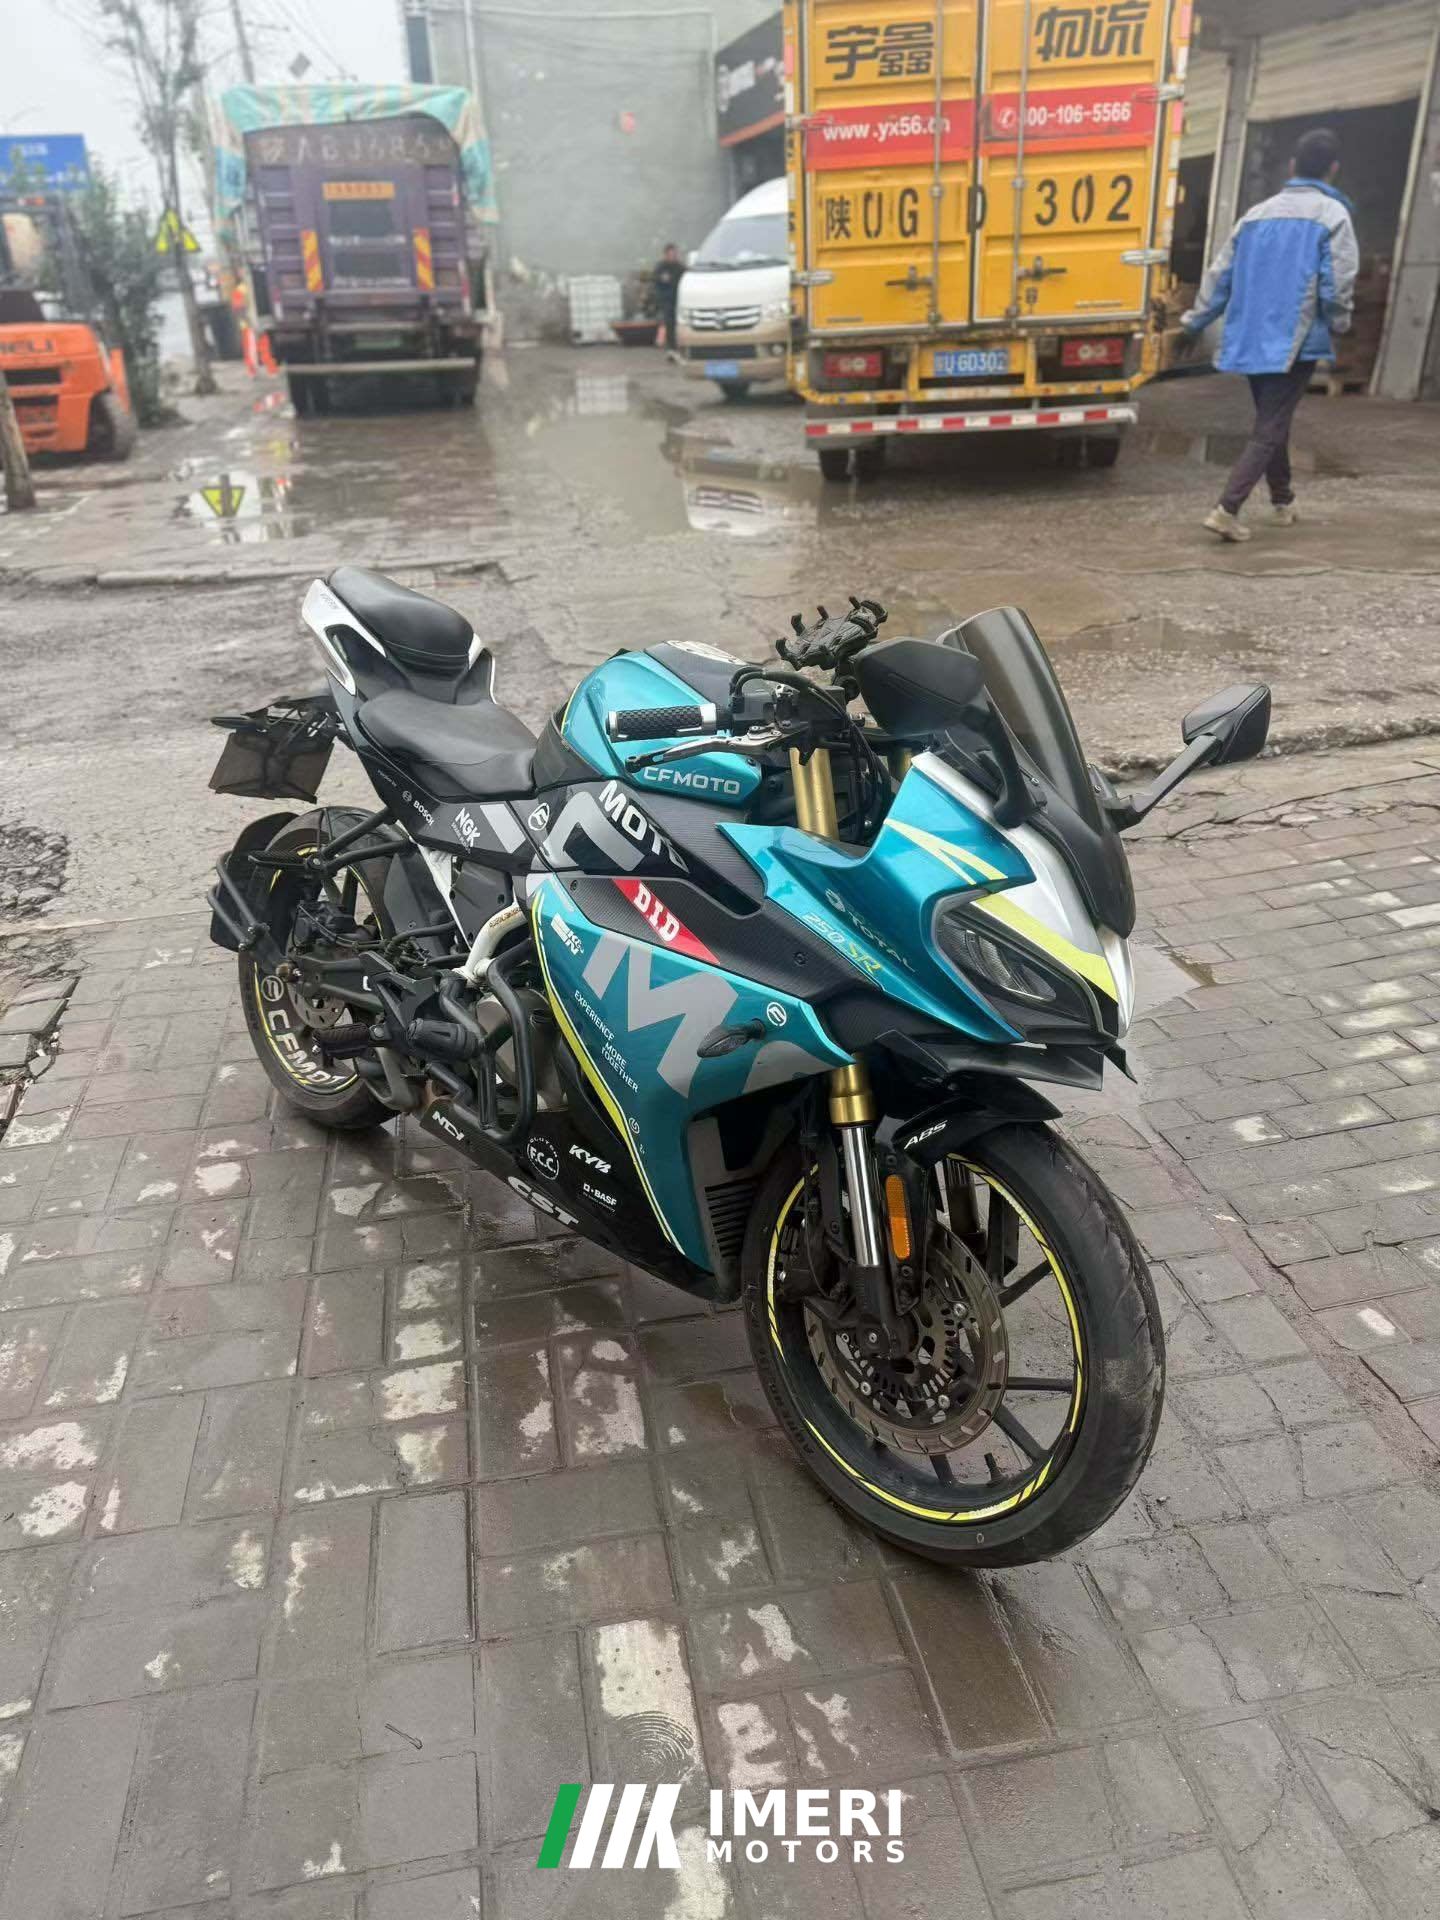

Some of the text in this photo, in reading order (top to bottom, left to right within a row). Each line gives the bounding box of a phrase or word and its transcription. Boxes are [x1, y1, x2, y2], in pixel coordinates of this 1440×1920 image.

[1034, 0, 1150, 62] 物流
[1021, 101, 1133, 127] 00-106-5566
[642, 766, 742, 796] CFMOTO
[412, 799, 435, 826] BOSCH
[454, 806, 481, 848] NGK
[801, 911, 882, 975] 250 SR
[574, 989, 615, 1041] EXPERIENCE
[601, 1047, 640, 1093] TOGETHER
[604, 1041, 627, 1070] MORE
[903, 1119, 948, 1150] ABS
[569, 1143, 612, 1174] KYB
[507, 1175, 580, 1226] CST
[594, 1188, 618, 1206] BASF
